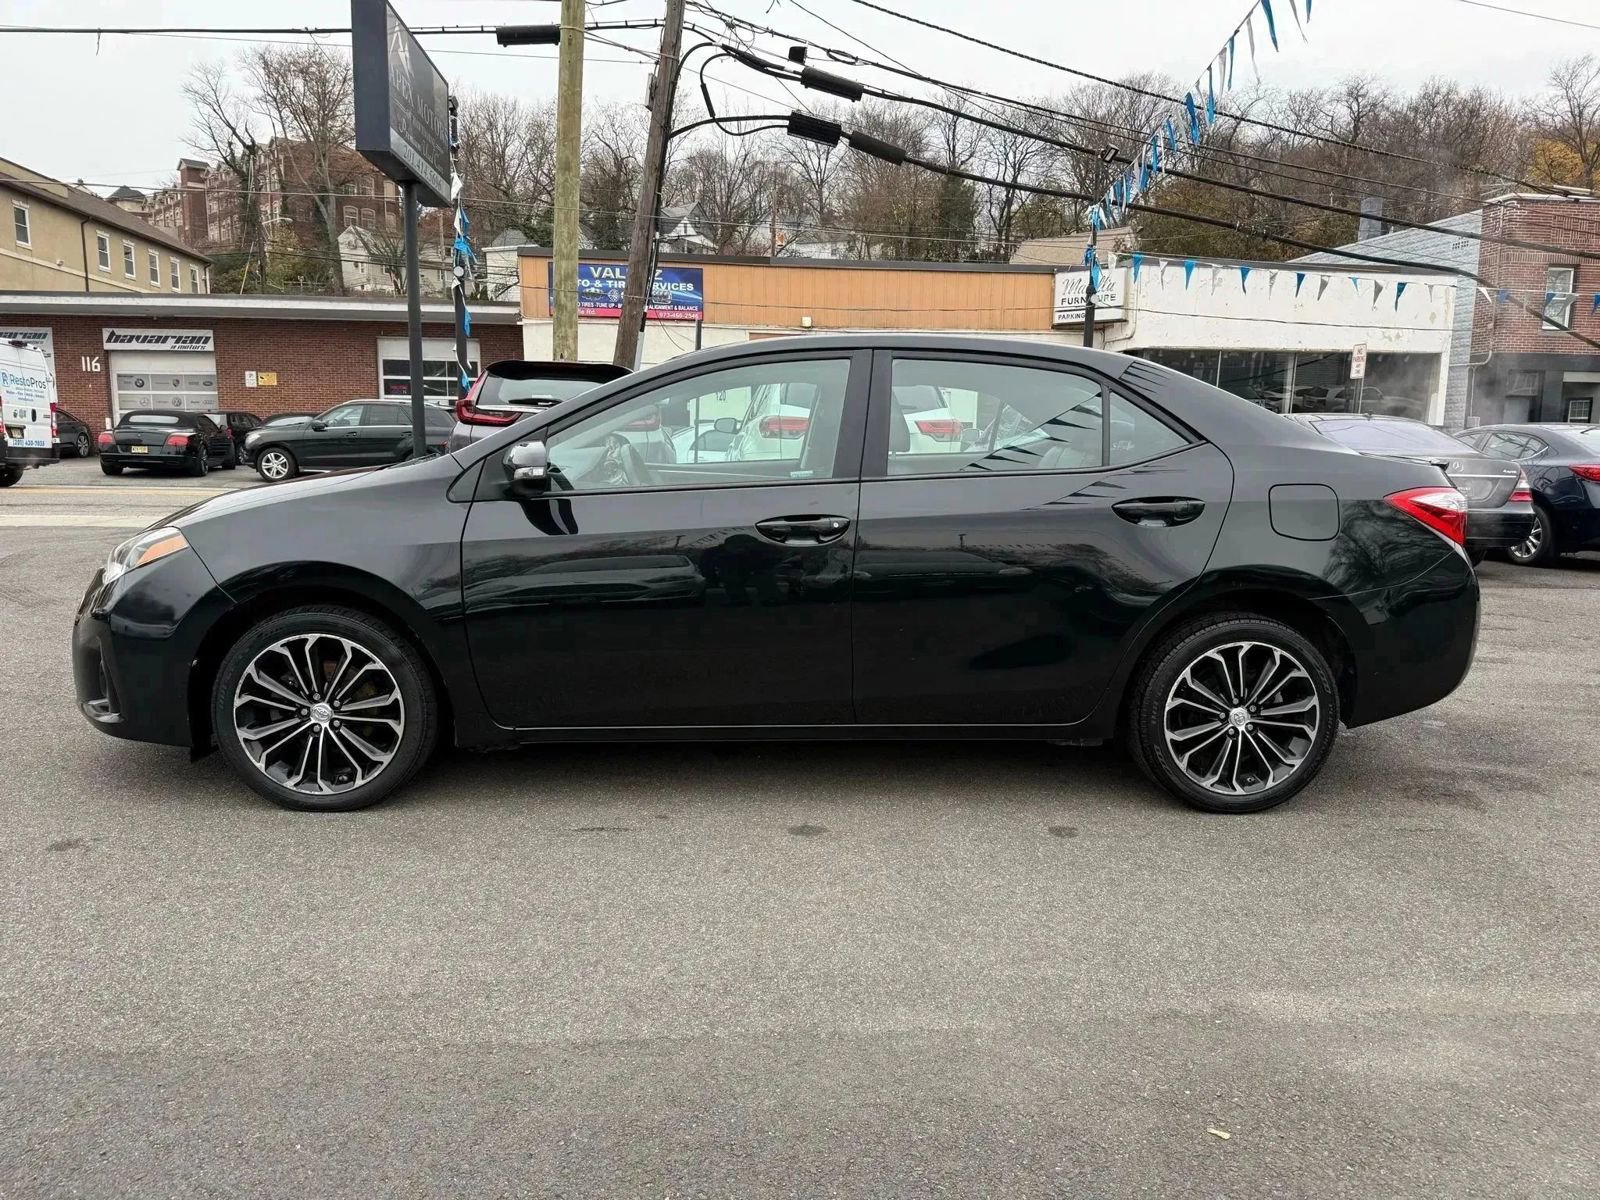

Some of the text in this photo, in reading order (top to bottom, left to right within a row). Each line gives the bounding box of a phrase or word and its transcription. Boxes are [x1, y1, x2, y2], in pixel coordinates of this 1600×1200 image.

[590, 266, 663, 281] VALZ
[594, 280, 602, 288] &
[606, 280, 626, 289] TIR
[653, 282, 694, 292] RVICES
[1061, 293, 1117, 306] FURNURE
[1058, 312, 1086, 321] PARKING
[105, 329, 212, 345] bavarian
[81, 356, 101, 372] 116
[10, 373, 47, 390] RestoPros
